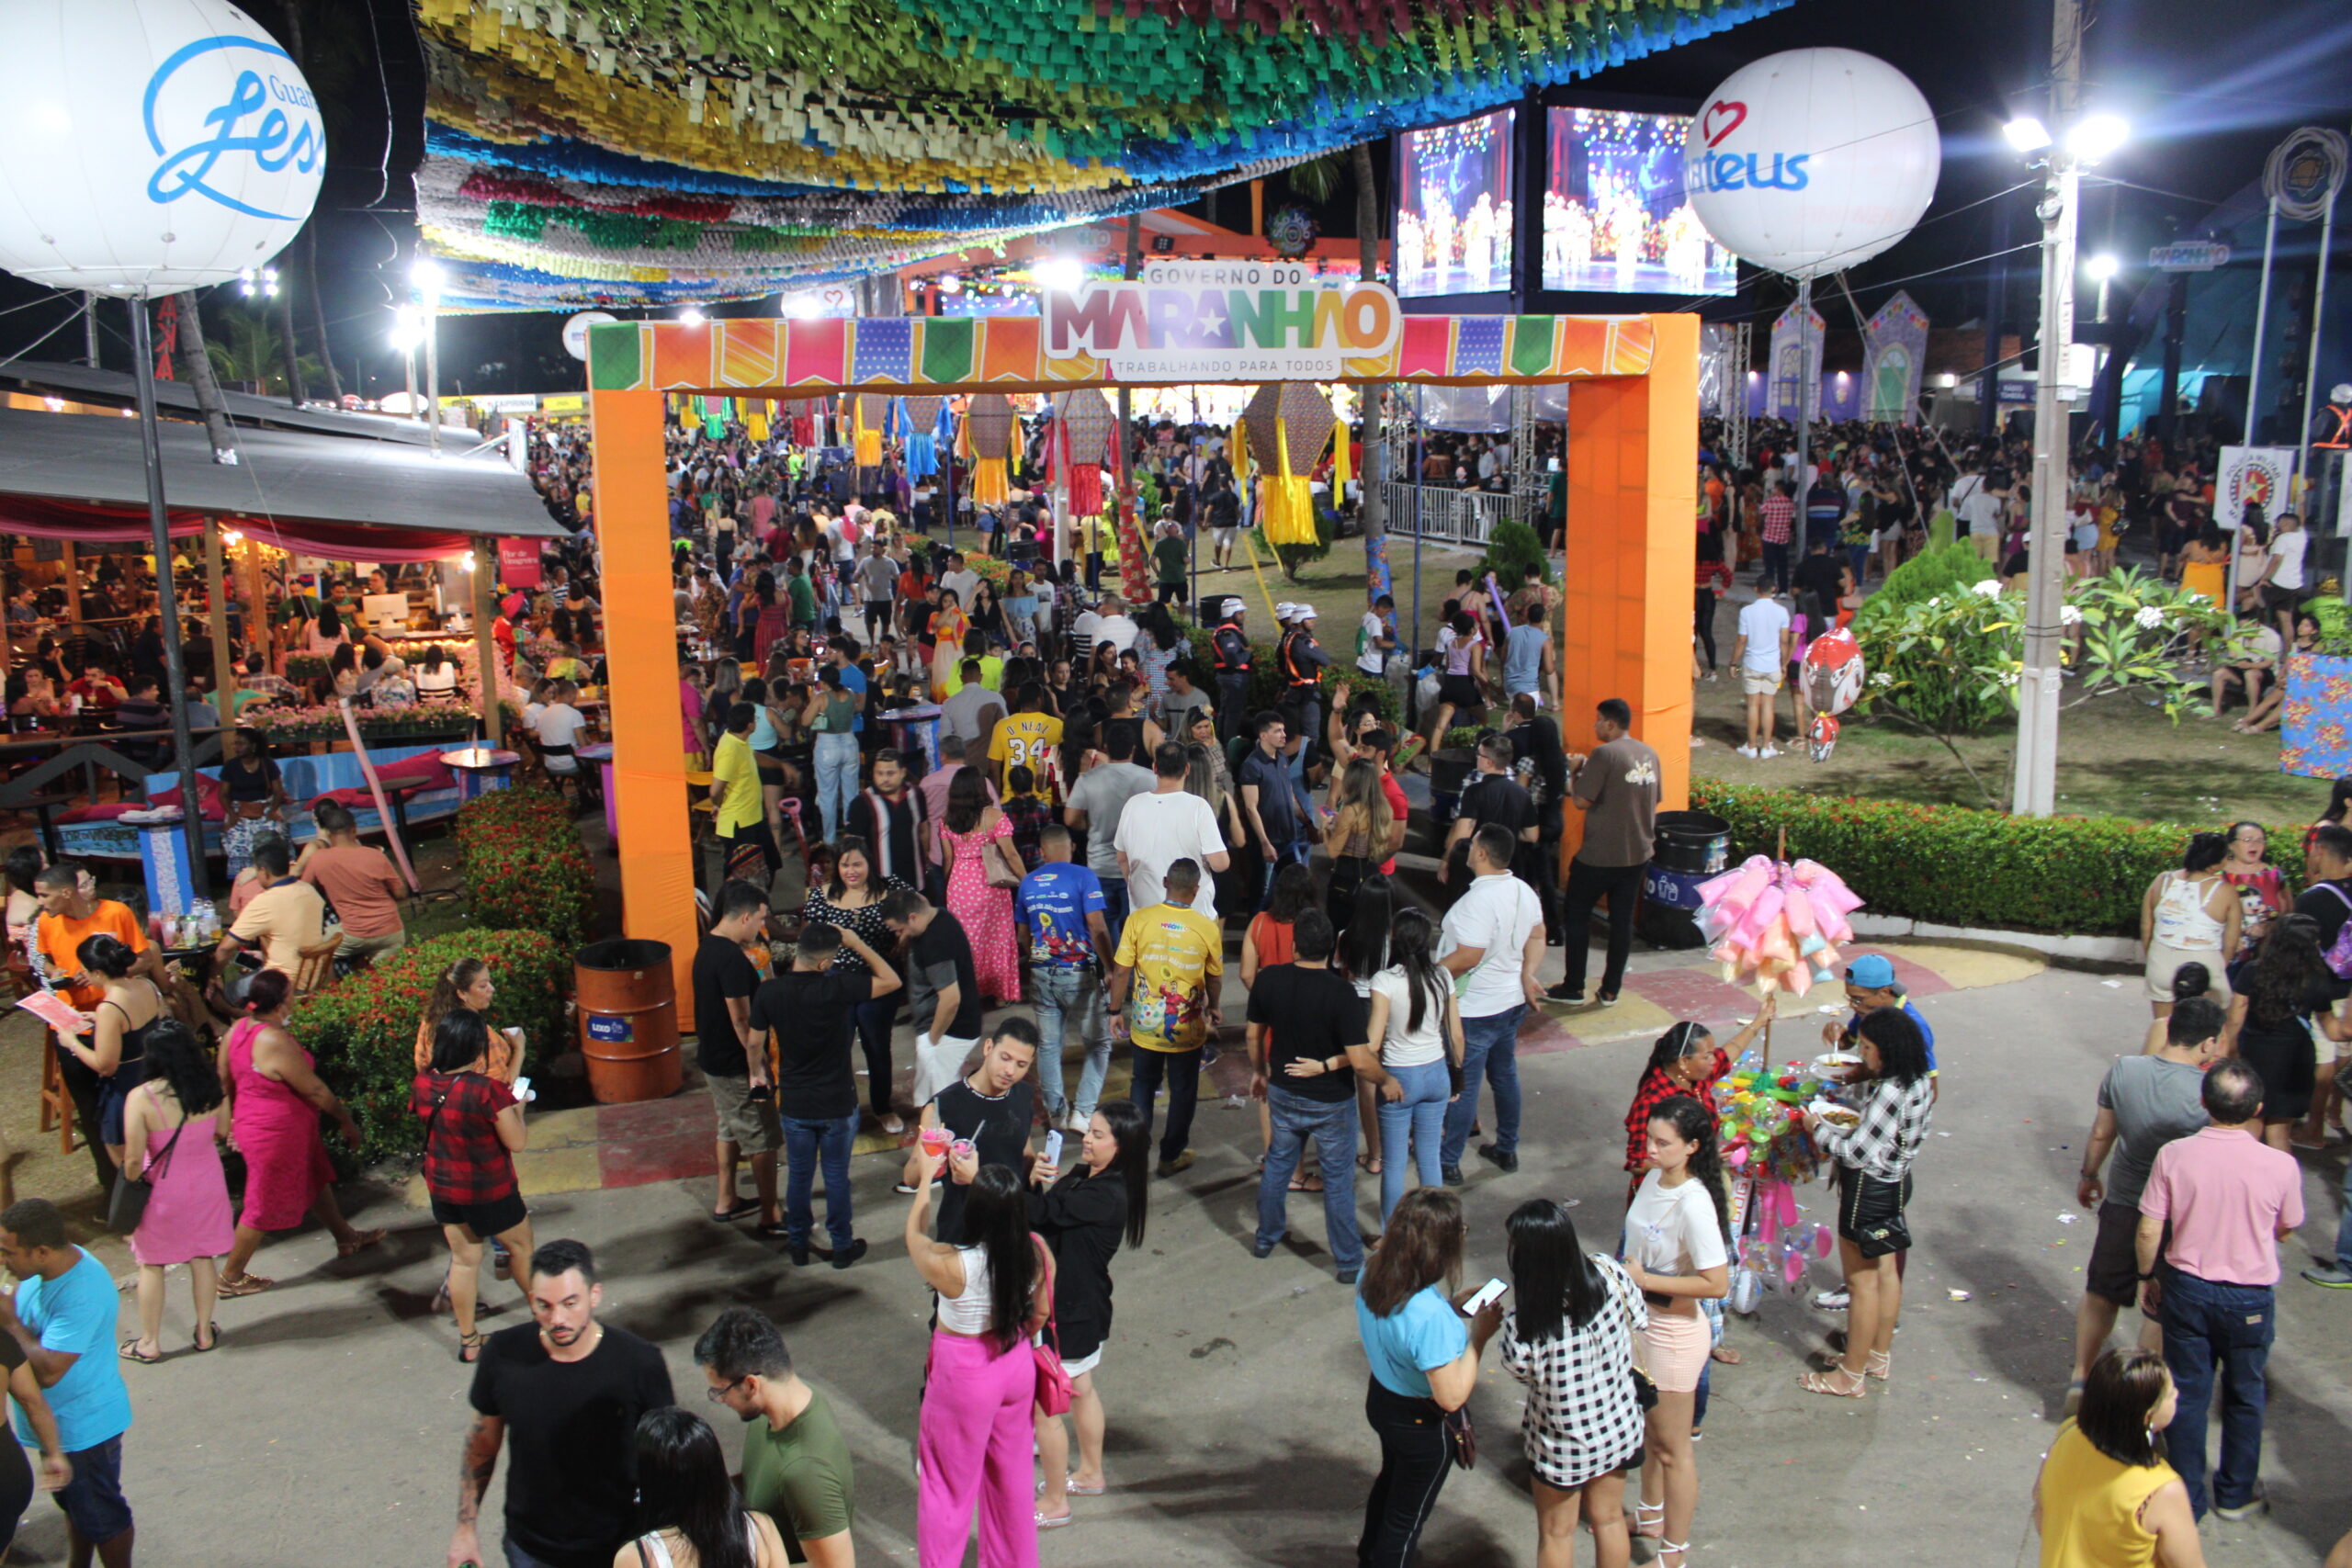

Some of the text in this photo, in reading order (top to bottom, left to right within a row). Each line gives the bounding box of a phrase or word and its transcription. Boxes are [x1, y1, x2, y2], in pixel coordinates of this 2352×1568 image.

[269, 74, 322, 110] Guar
[1685, 149, 1810, 194] ateus
[1149, 267, 1302, 285] GOVERNO DO
[1050, 281, 1391, 350] MARANHÃO
[1116, 358, 1334, 374] TRABALHANDO PARA TODOS
[1008, 738, 1046, 766] 34
[592, 1023, 611, 1033] LIXO
